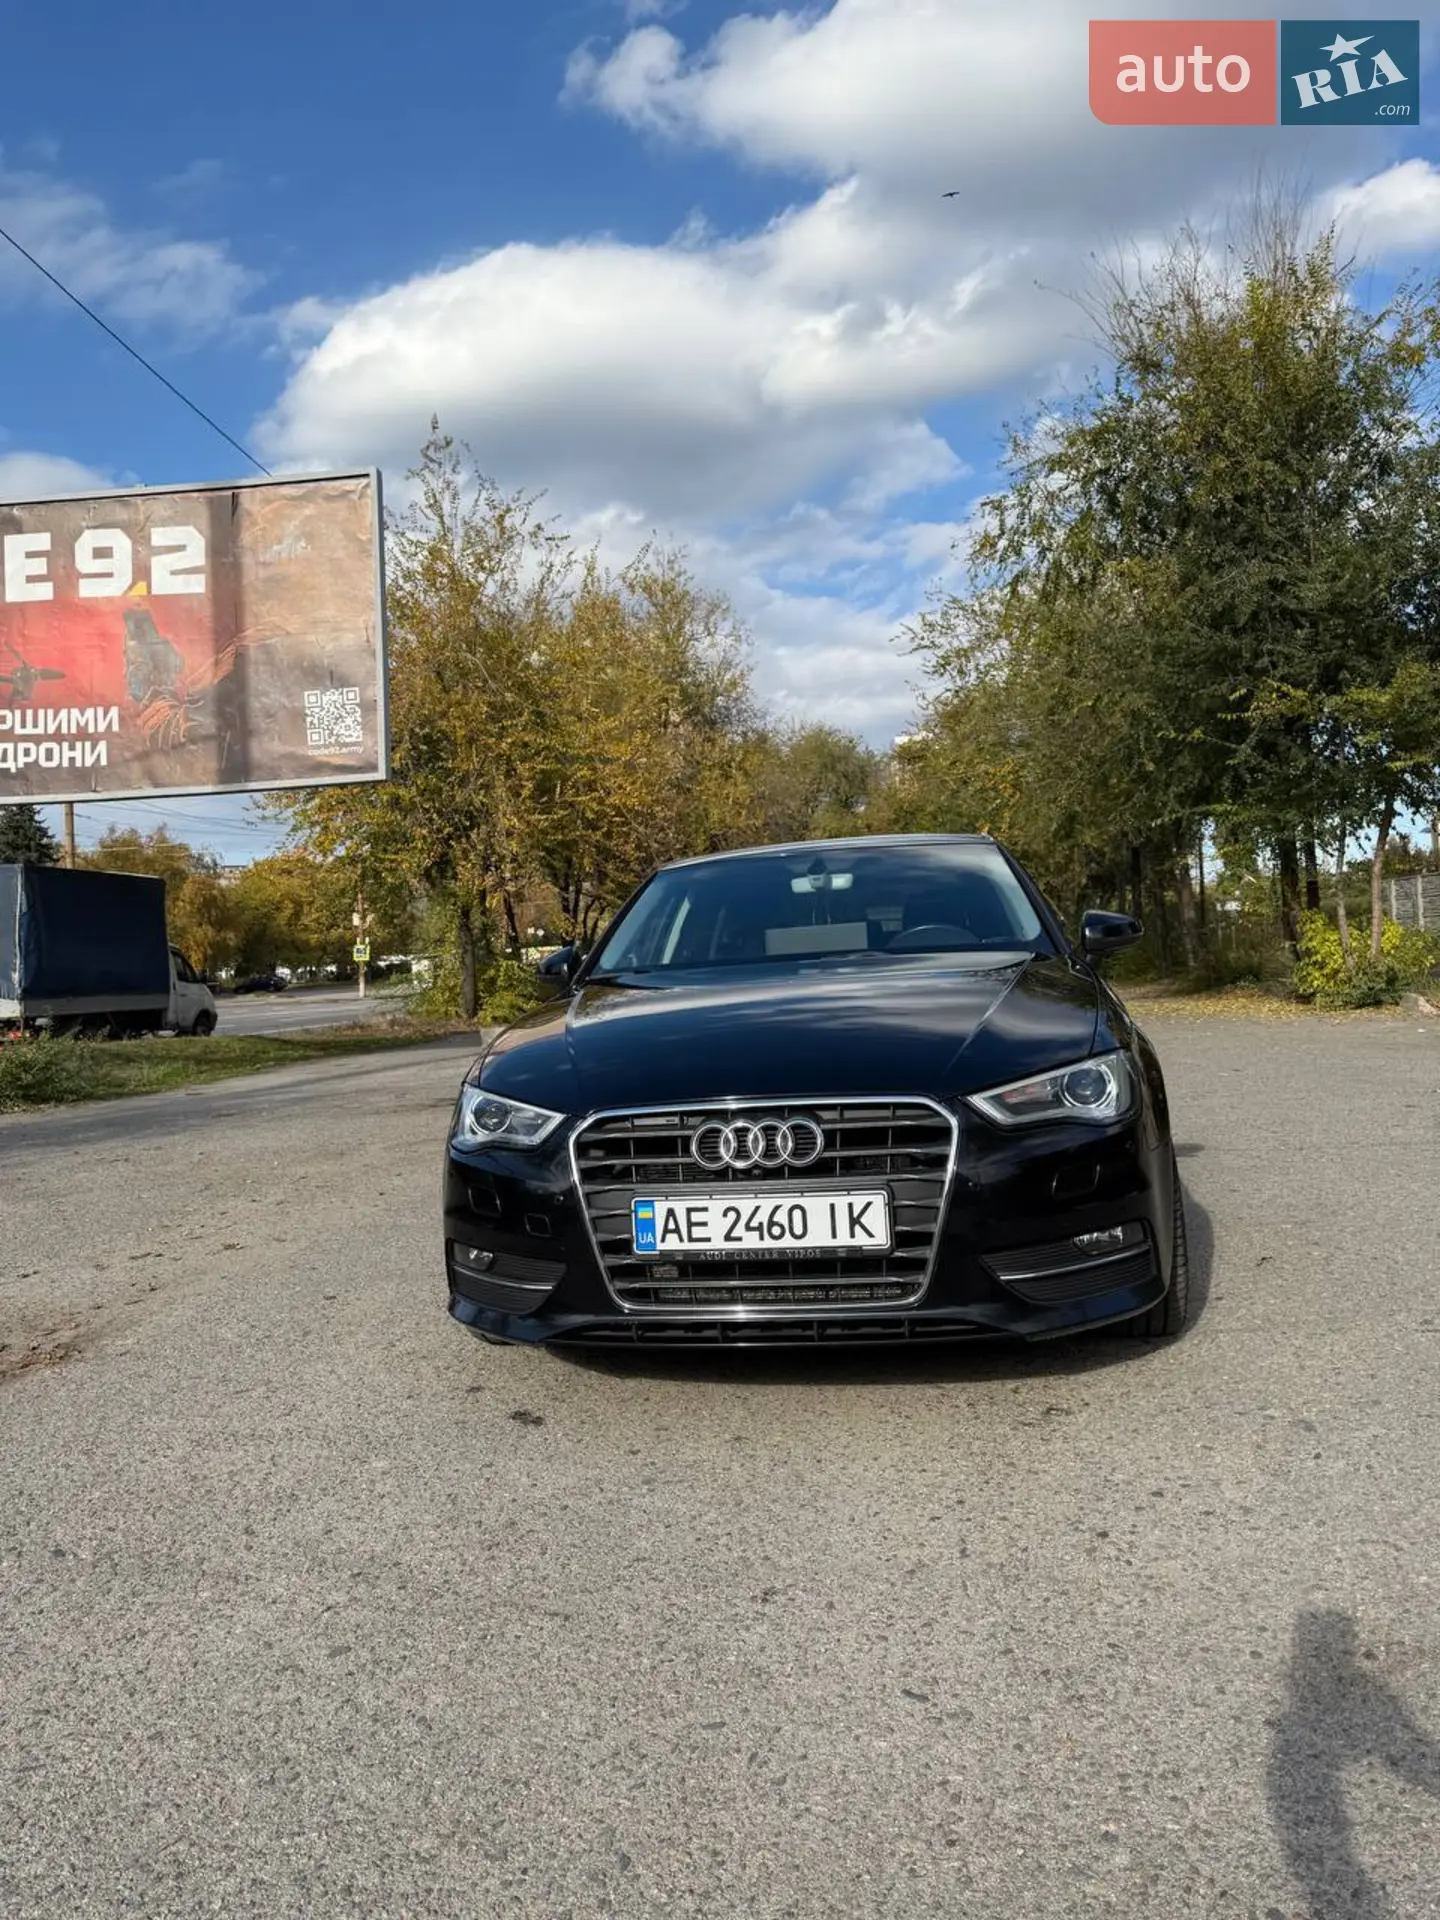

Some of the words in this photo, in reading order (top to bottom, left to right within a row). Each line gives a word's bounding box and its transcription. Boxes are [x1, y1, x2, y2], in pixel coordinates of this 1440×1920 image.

[4, 532, 54, 603] E
[0, 740, 108, 773] ДРОНИ
[638, 1232, 655, 1244] UA
[660, 1206, 712, 1243] AE
[721, 1204, 808, 1242] 2460
[829, 1201, 876, 1240] IK
[698, 1250, 727, 1260] AUDI
[734, 1250, 779, 1260] CENTER
